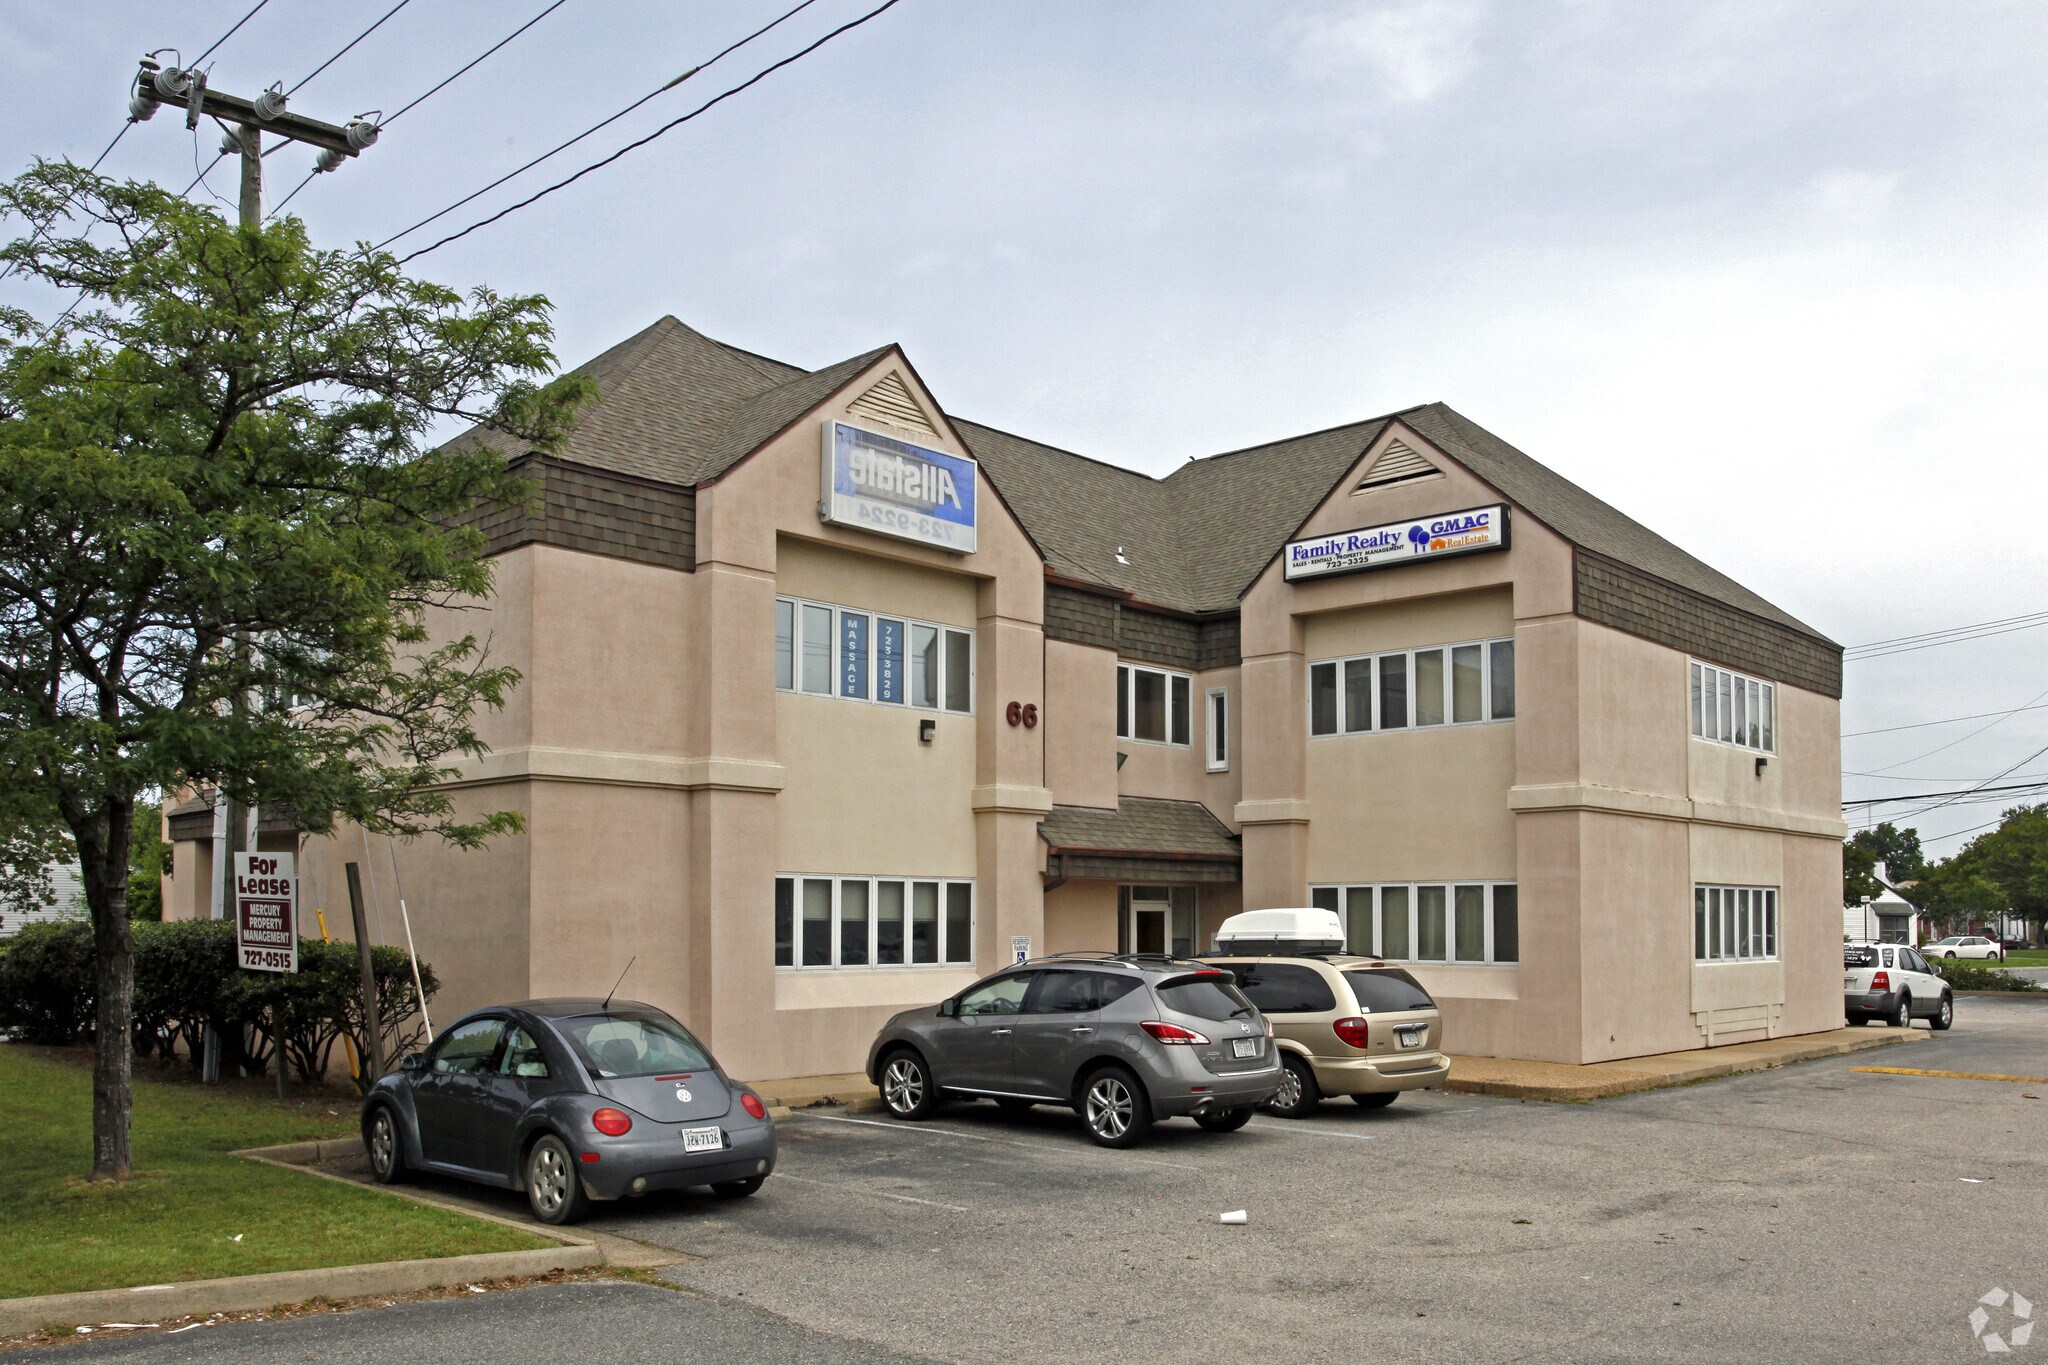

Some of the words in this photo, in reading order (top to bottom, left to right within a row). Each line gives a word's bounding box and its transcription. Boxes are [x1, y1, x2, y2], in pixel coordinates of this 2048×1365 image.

[1430, 513, 1489, 534] GMAC
[1292, 539, 1345, 561] Family
[1347, 530, 1401, 551] Realty
[1311, 556, 1333, 565] RENTALS
[1337, 551, 1363, 560] PROPERTY
[1365, 544, 1404, 556] MANAGEMENT
[1326, 556, 1369, 569] 723-3325
[847, 620, 858, 694] MASSAGE
[1006, 701, 1038, 729] 66
[248, 856, 277, 875] For
[238, 875, 290, 895] Lease
[249, 903, 281, 916] MERCURY
[249, 916, 283, 930] PROPERTY
[243, 929, 290, 943] MANAGEMENT
[244, 950, 291, 968] 727-0515
